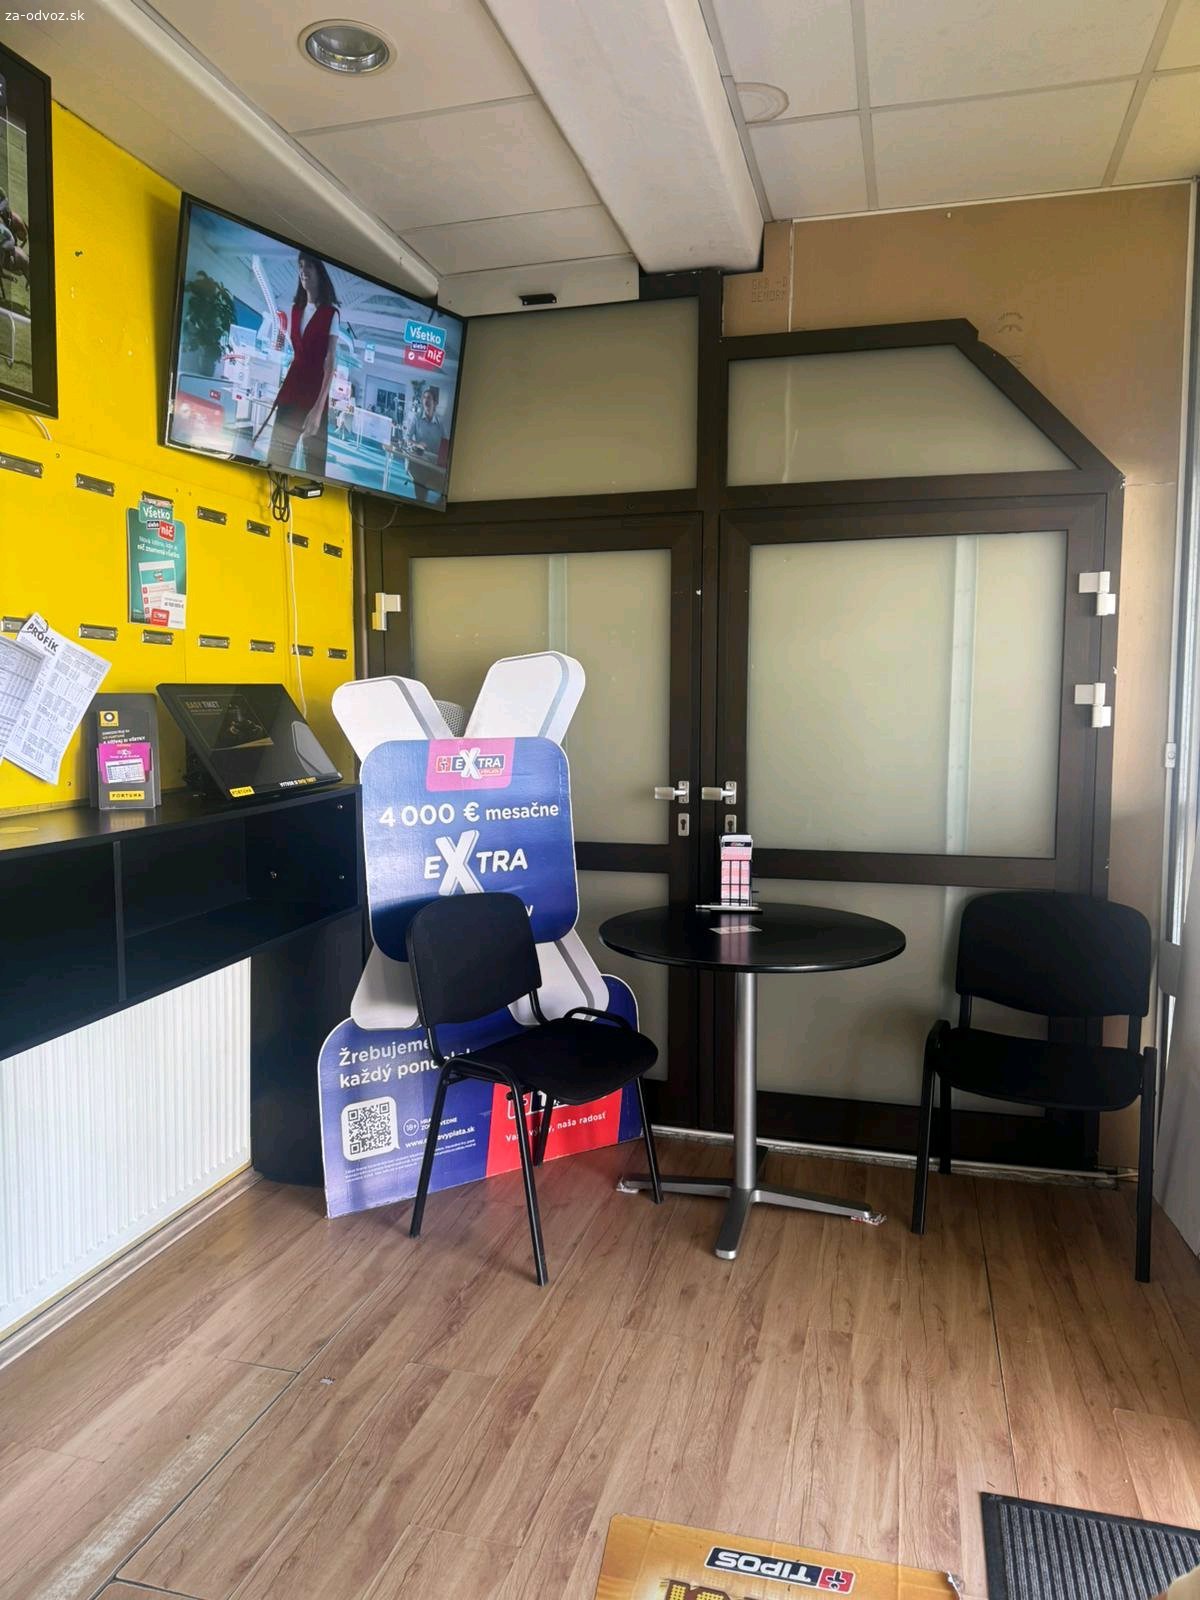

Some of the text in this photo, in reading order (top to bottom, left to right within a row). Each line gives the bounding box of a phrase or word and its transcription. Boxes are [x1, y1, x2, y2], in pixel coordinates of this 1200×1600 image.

[410, 326, 442, 344] Všetko
[427, 349, 443, 363] nič
[142, 505, 171, 520] Všetko
[160, 525, 174, 538] nič
[27, 624, 59, 653] PROFÍK
[454, 747, 502, 780] EXTRA
[463, 801, 480, 823] €
[485, 802, 559, 821] mesačne
[424, 829, 528, 897] EXTRA
[340, 1063, 392, 1089] každý
[557, 1117, 577, 1129] naša
[579, 1110, 607, 1125] radosť
[715, 1551, 811, 1583] TIPOS
